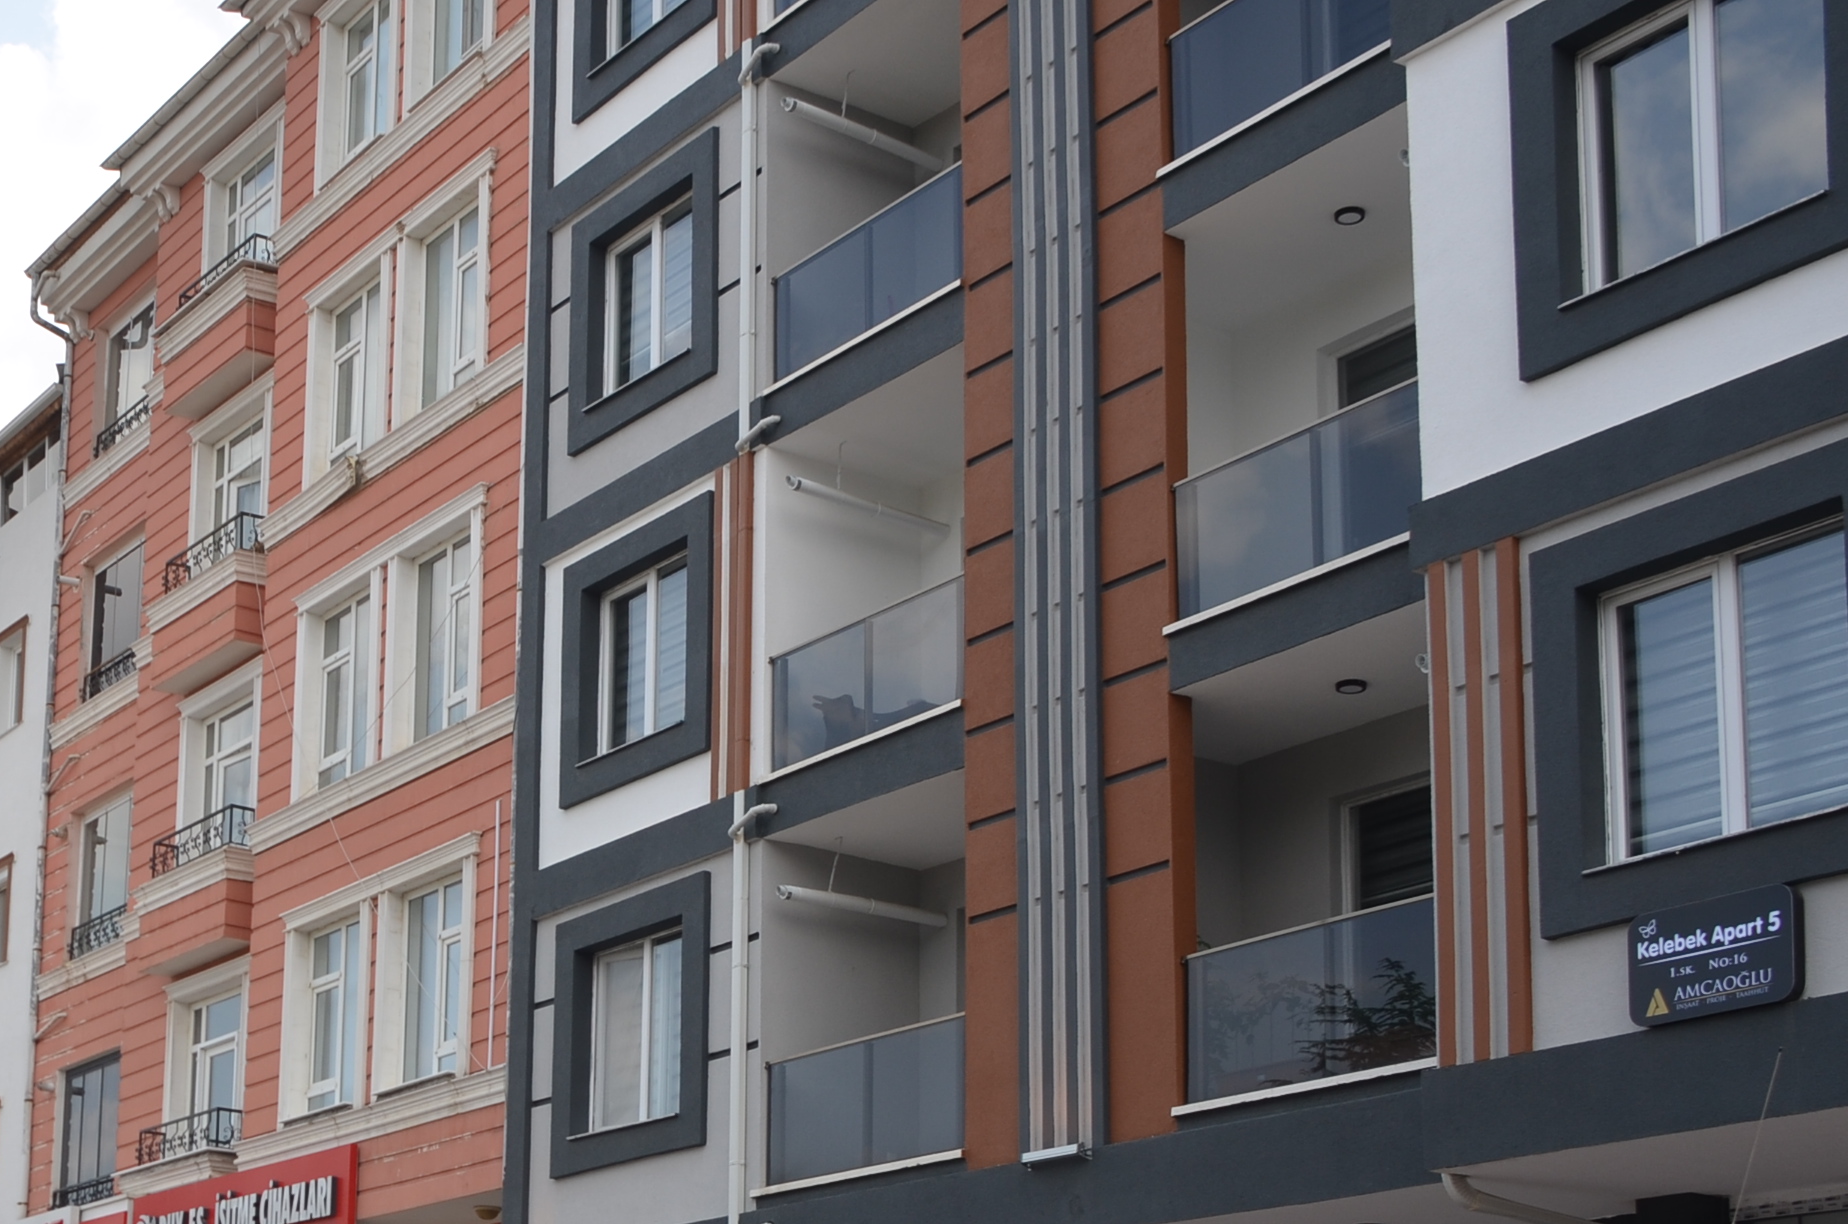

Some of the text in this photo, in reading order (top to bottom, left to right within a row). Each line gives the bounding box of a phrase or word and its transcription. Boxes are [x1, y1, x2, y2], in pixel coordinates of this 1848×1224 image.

[1637, 910, 1782, 960] Kelebek Apart 5
[1674, 967, 1773, 1001] AMCAOĞLU
